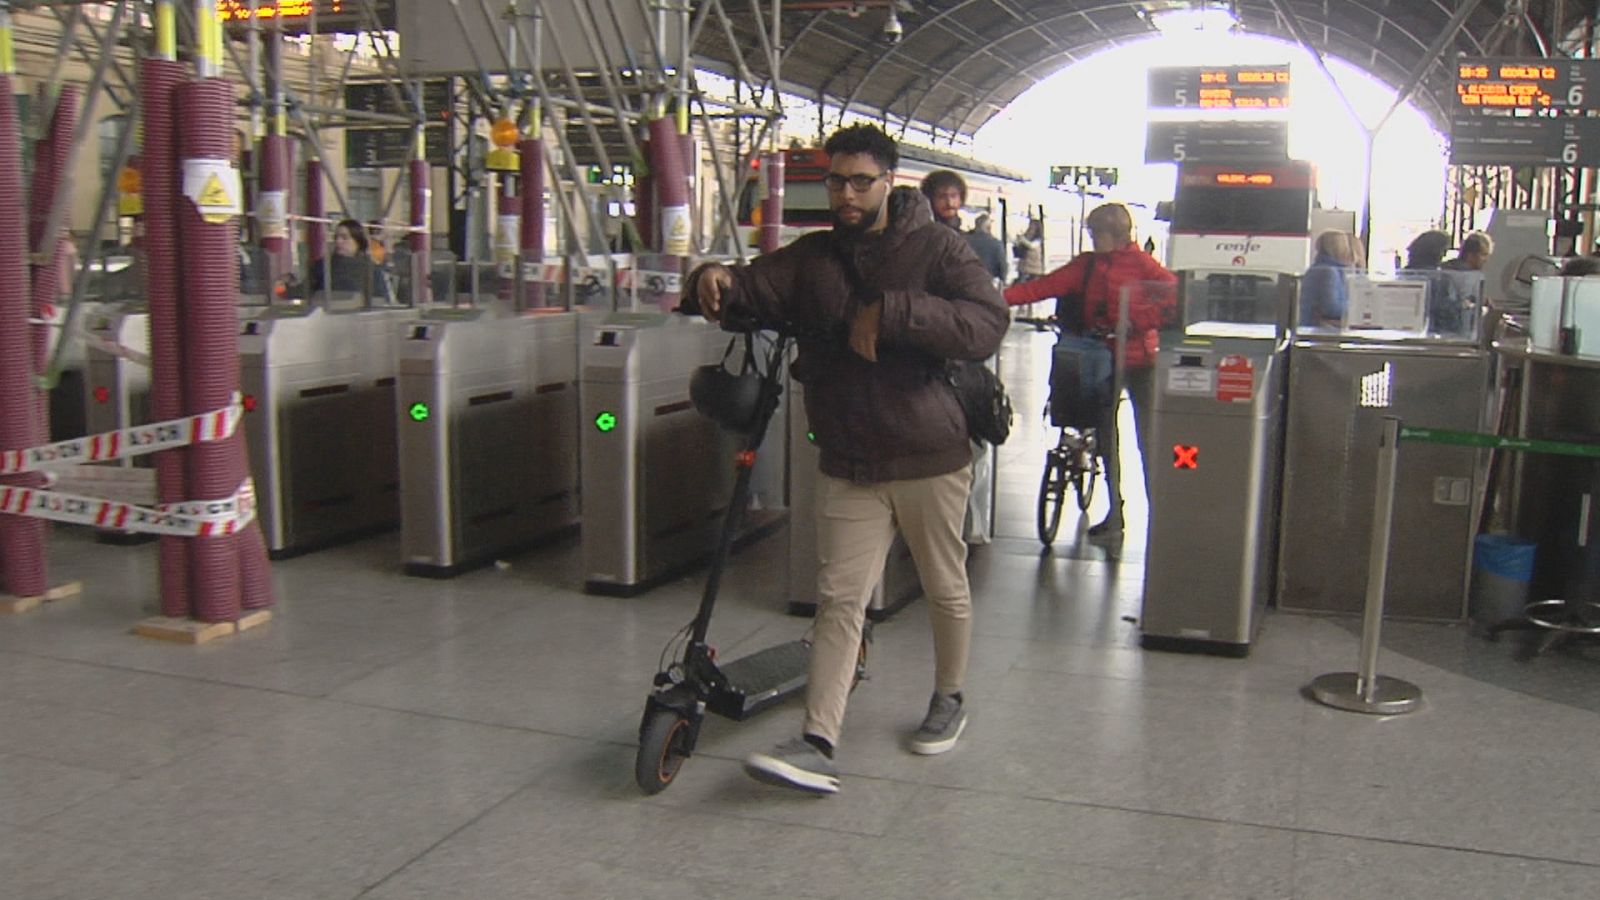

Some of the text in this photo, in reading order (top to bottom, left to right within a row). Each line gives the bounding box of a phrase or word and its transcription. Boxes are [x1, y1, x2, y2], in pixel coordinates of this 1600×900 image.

[1175, 89, 1187, 107] 5
[1568, 85, 1583, 106] 6
[1173, 144, 1185, 160] 5
[1562, 144, 1577, 164] 6
[1215, 240, 1261, 255] renfe
